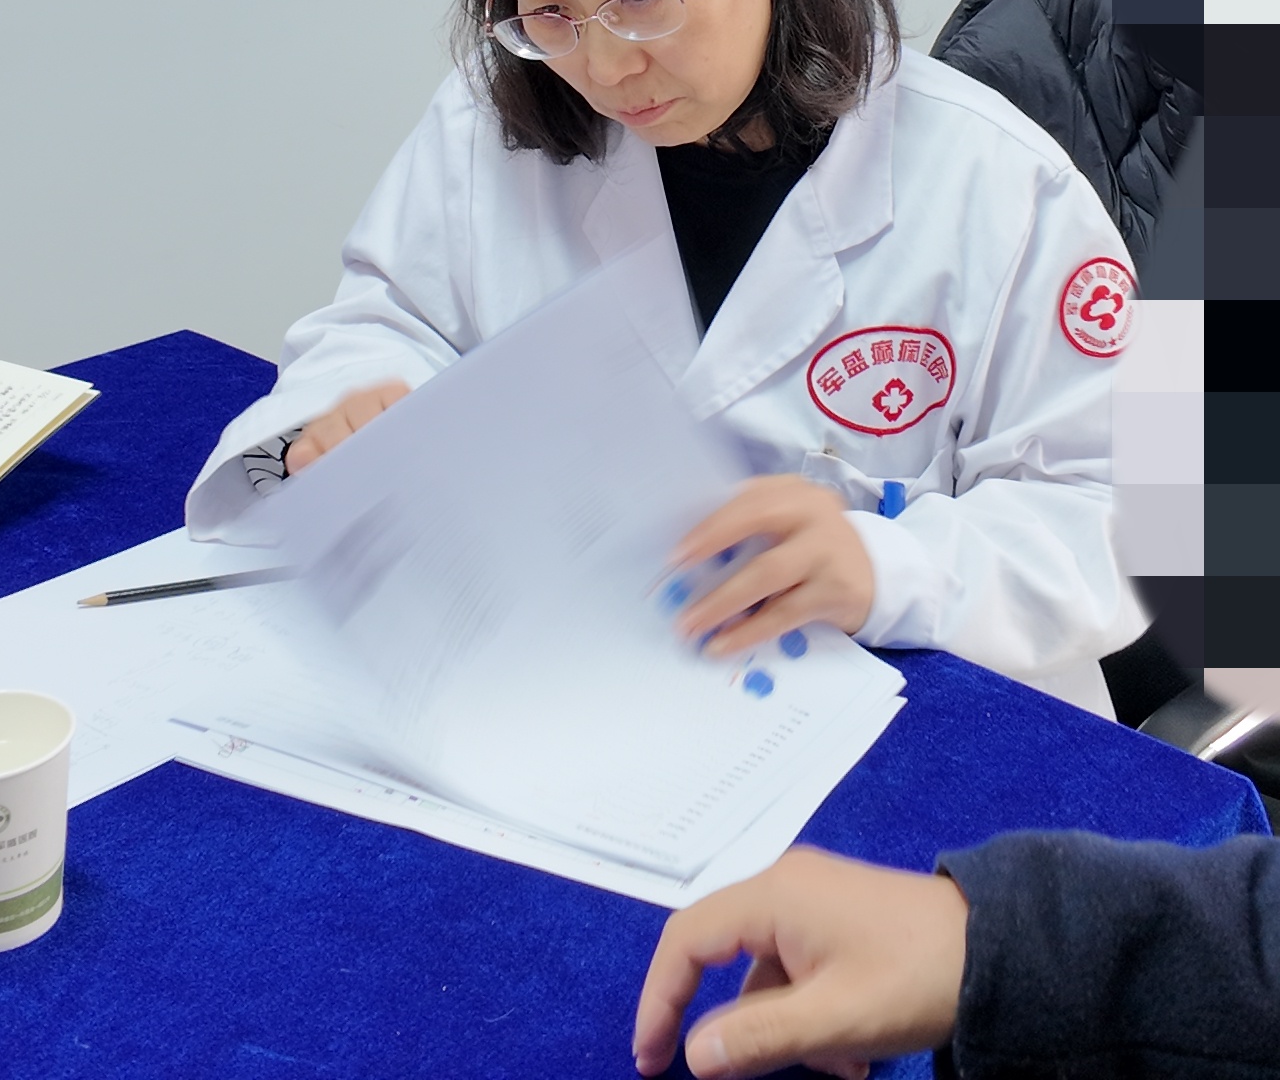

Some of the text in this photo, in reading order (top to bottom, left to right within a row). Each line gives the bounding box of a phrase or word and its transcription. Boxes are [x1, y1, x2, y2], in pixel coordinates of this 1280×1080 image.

[817, 339, 949, 397] 军盛癫痫医院
